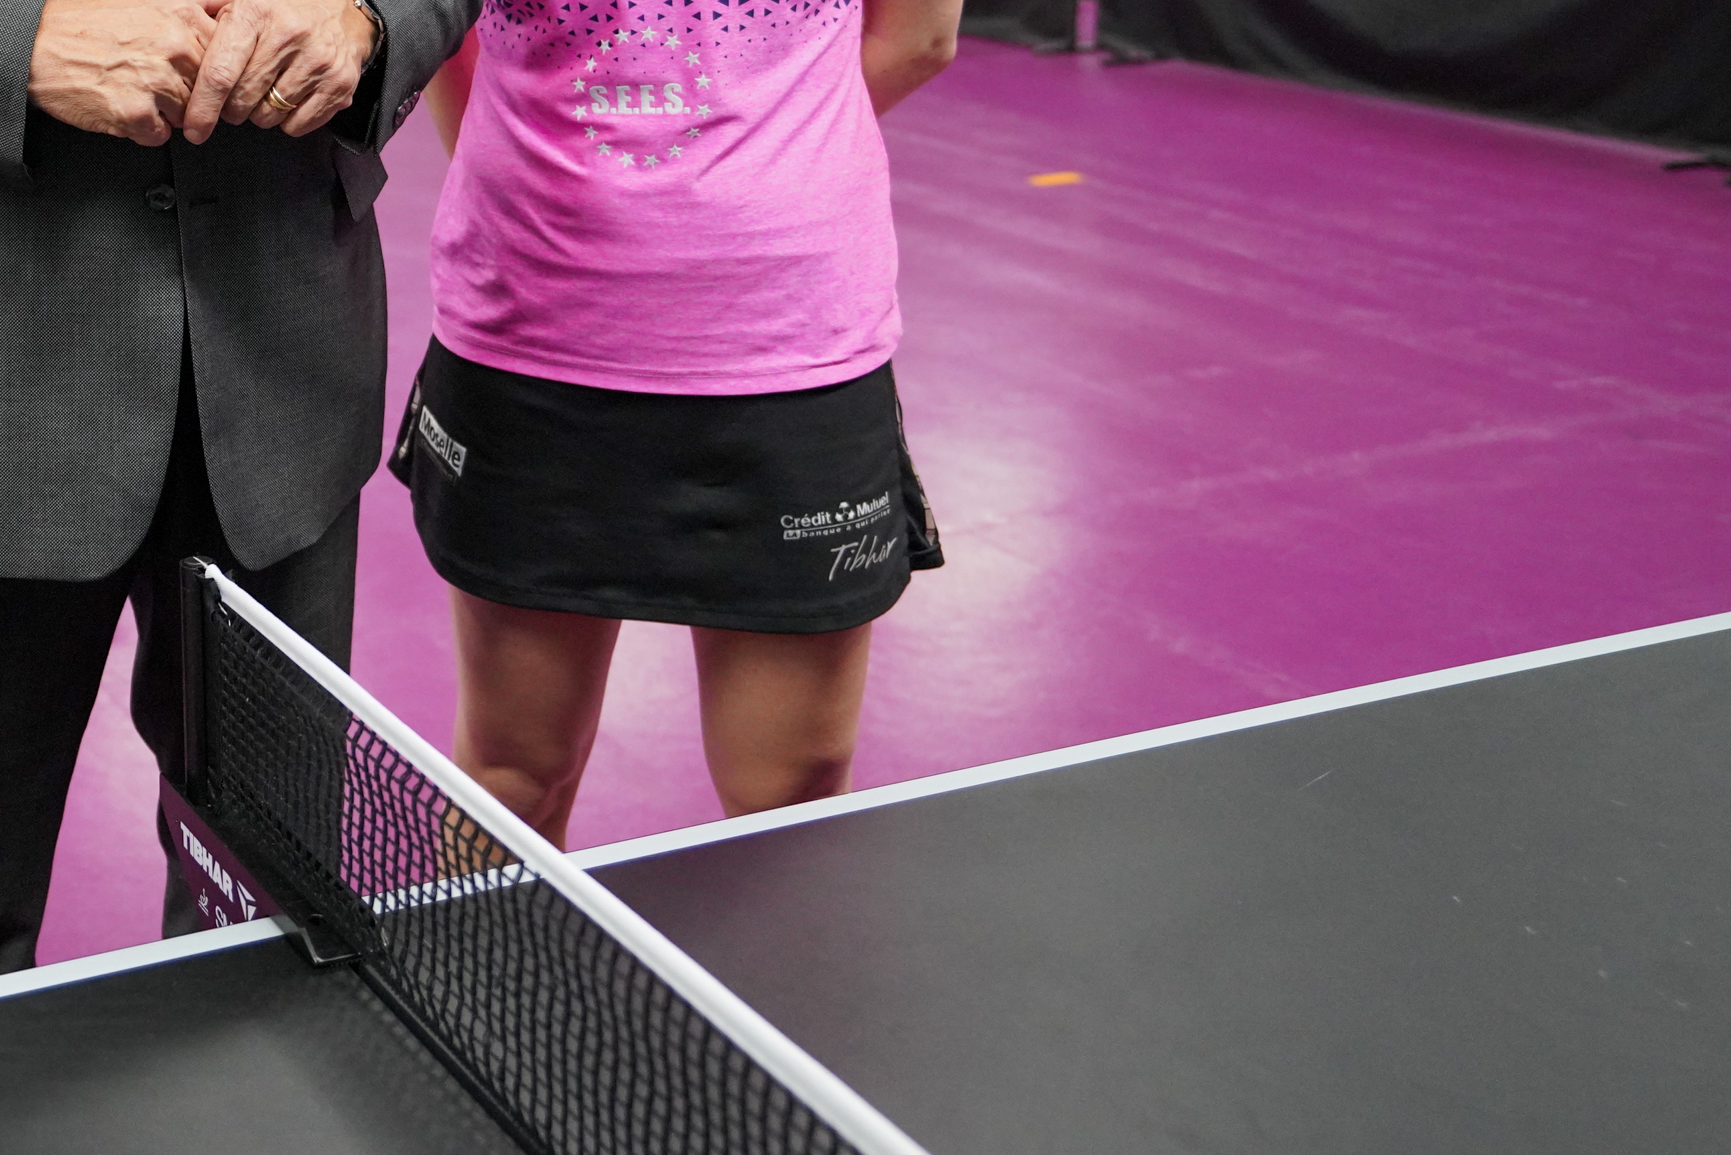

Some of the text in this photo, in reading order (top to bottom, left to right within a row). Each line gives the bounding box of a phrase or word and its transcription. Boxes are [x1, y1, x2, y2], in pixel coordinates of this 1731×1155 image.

[589, 82, 691, 115] S.E.E.S.
[420, 411, 461, 468] Moselle
[780, 491, 889, 529] Crédit Mutuel
[801, 527, 841, 538] banque
[855, 520, 868, 529] qui
[828, 534, 897, 581] Tibhar
[179, 821, 234, 903] TIBHAR
